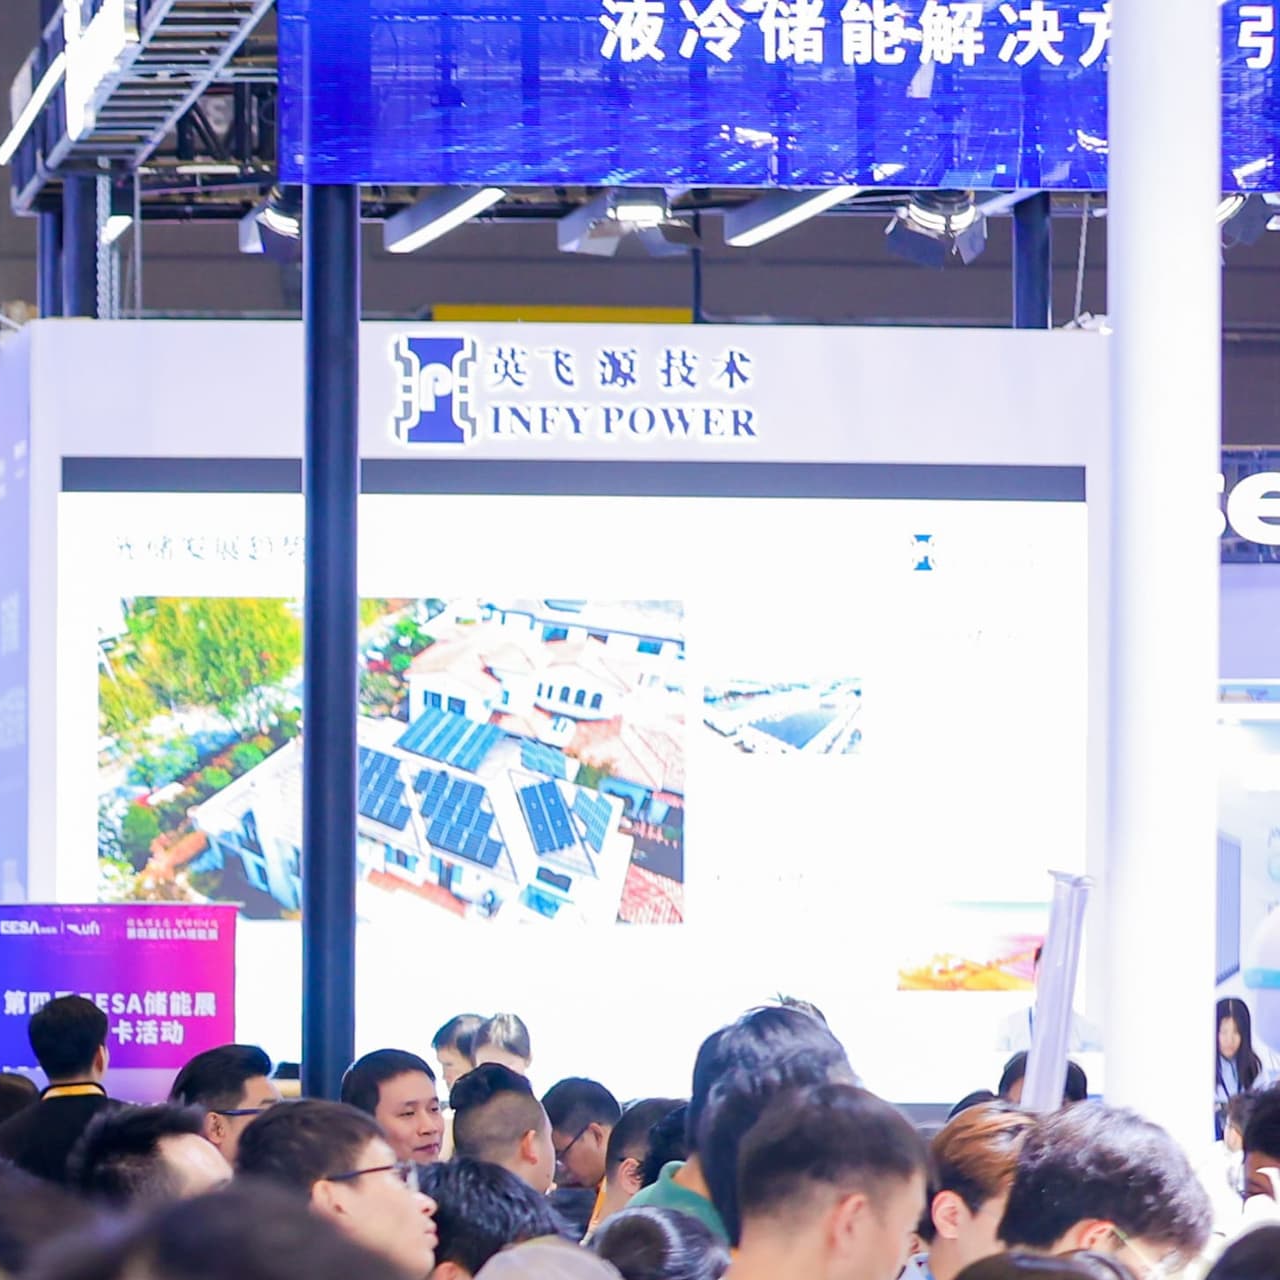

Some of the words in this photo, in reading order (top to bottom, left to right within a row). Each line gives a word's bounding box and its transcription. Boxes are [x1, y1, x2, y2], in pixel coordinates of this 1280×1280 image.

[490, 347, 752, 389] 英飞源技术
[491, 406, 586, 436] INFY
[604, 407, 758, 437] POWER
